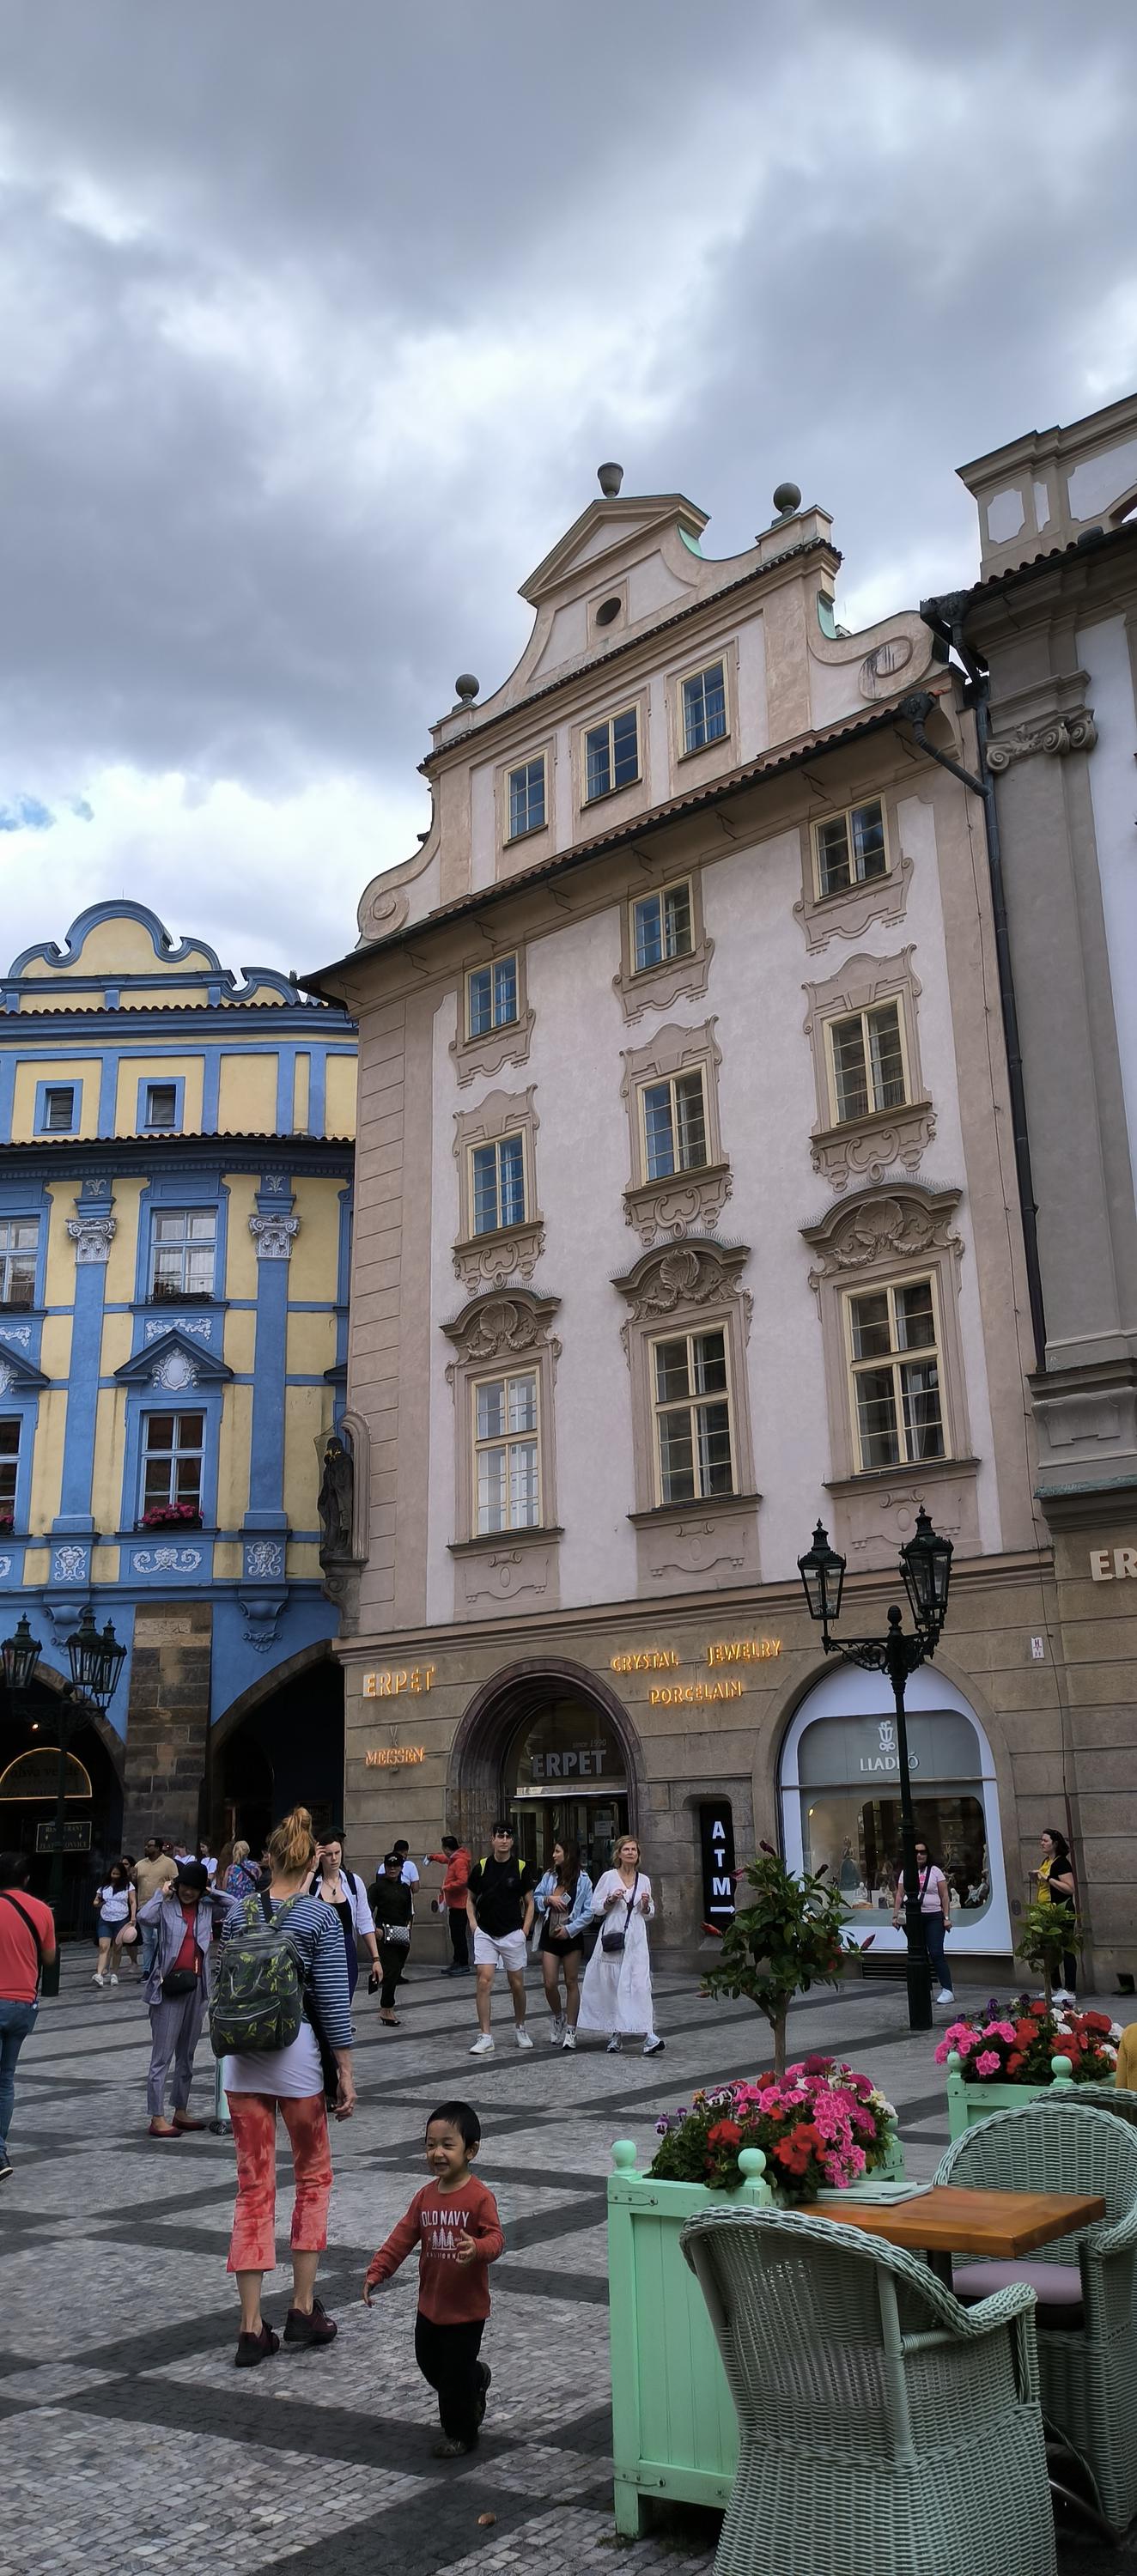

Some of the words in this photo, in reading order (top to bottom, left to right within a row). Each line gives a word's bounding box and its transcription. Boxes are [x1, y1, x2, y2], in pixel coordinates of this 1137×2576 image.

[611, 1651, 679, 1672] CRYSTAL
[708, 1640, 781, 1666] JEWELRY
[363, 1667, 435, 1697] ERPET
[648, 1680, 743, 1704] PORCELAIN
[532, 1749, 607, 1777] ERPET
[712, 1821, 732, 1896] ATM
[422, 2211, 438, 2227] OLD
[441, 2210, 470, 2228] NAVY
